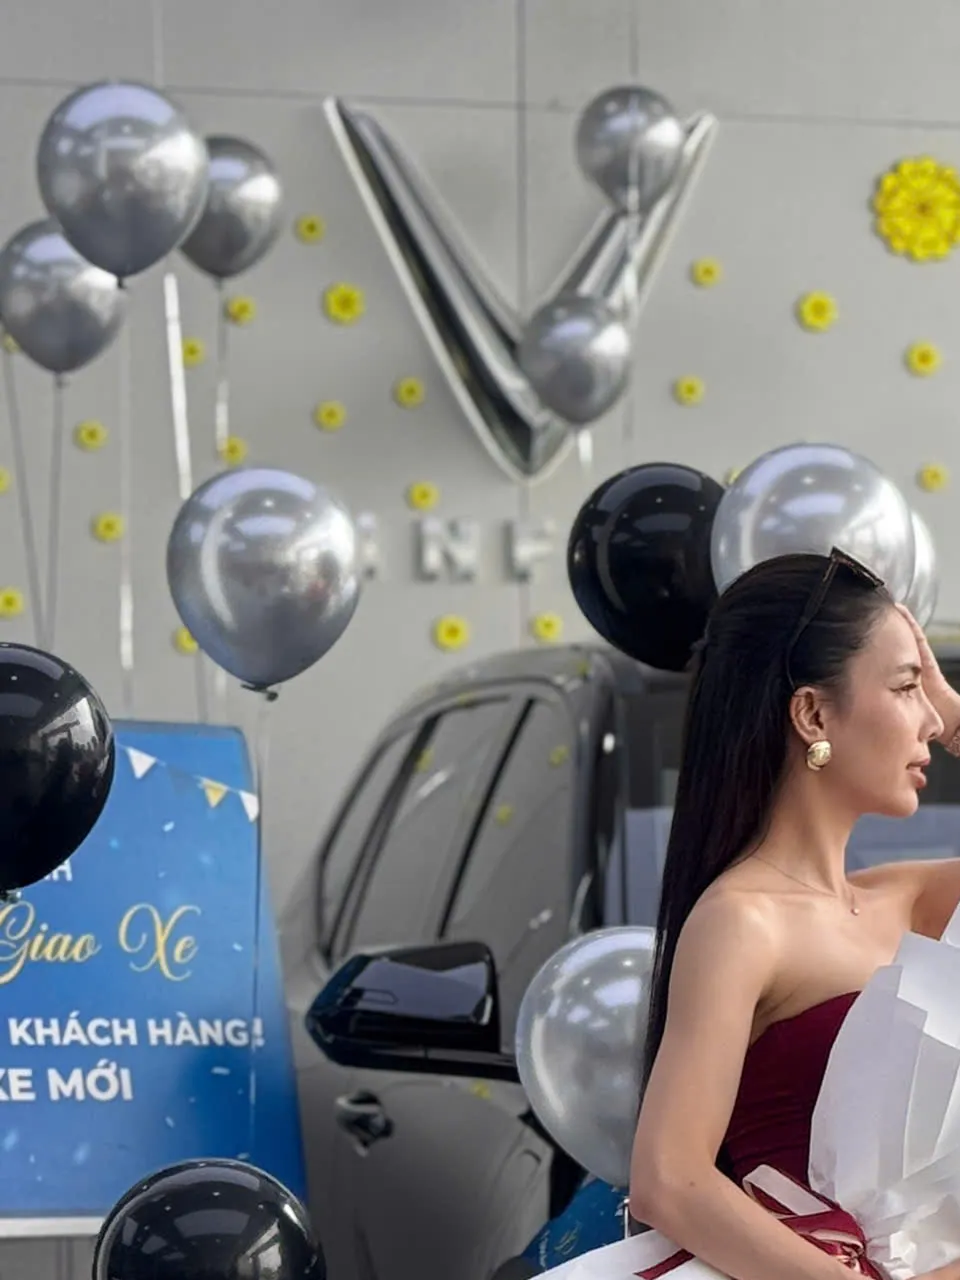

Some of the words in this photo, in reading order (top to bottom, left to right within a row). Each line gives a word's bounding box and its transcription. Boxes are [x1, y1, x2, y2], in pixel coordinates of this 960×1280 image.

[0, 899, 102, 985] Giao
[118, 903, 201, 981] Xe
[8, 1010, 138, 1046] KHÁCH
[147, 1011, 265, 1047] HÀNG!
[47, 1058, 133, 1101] MỚI
